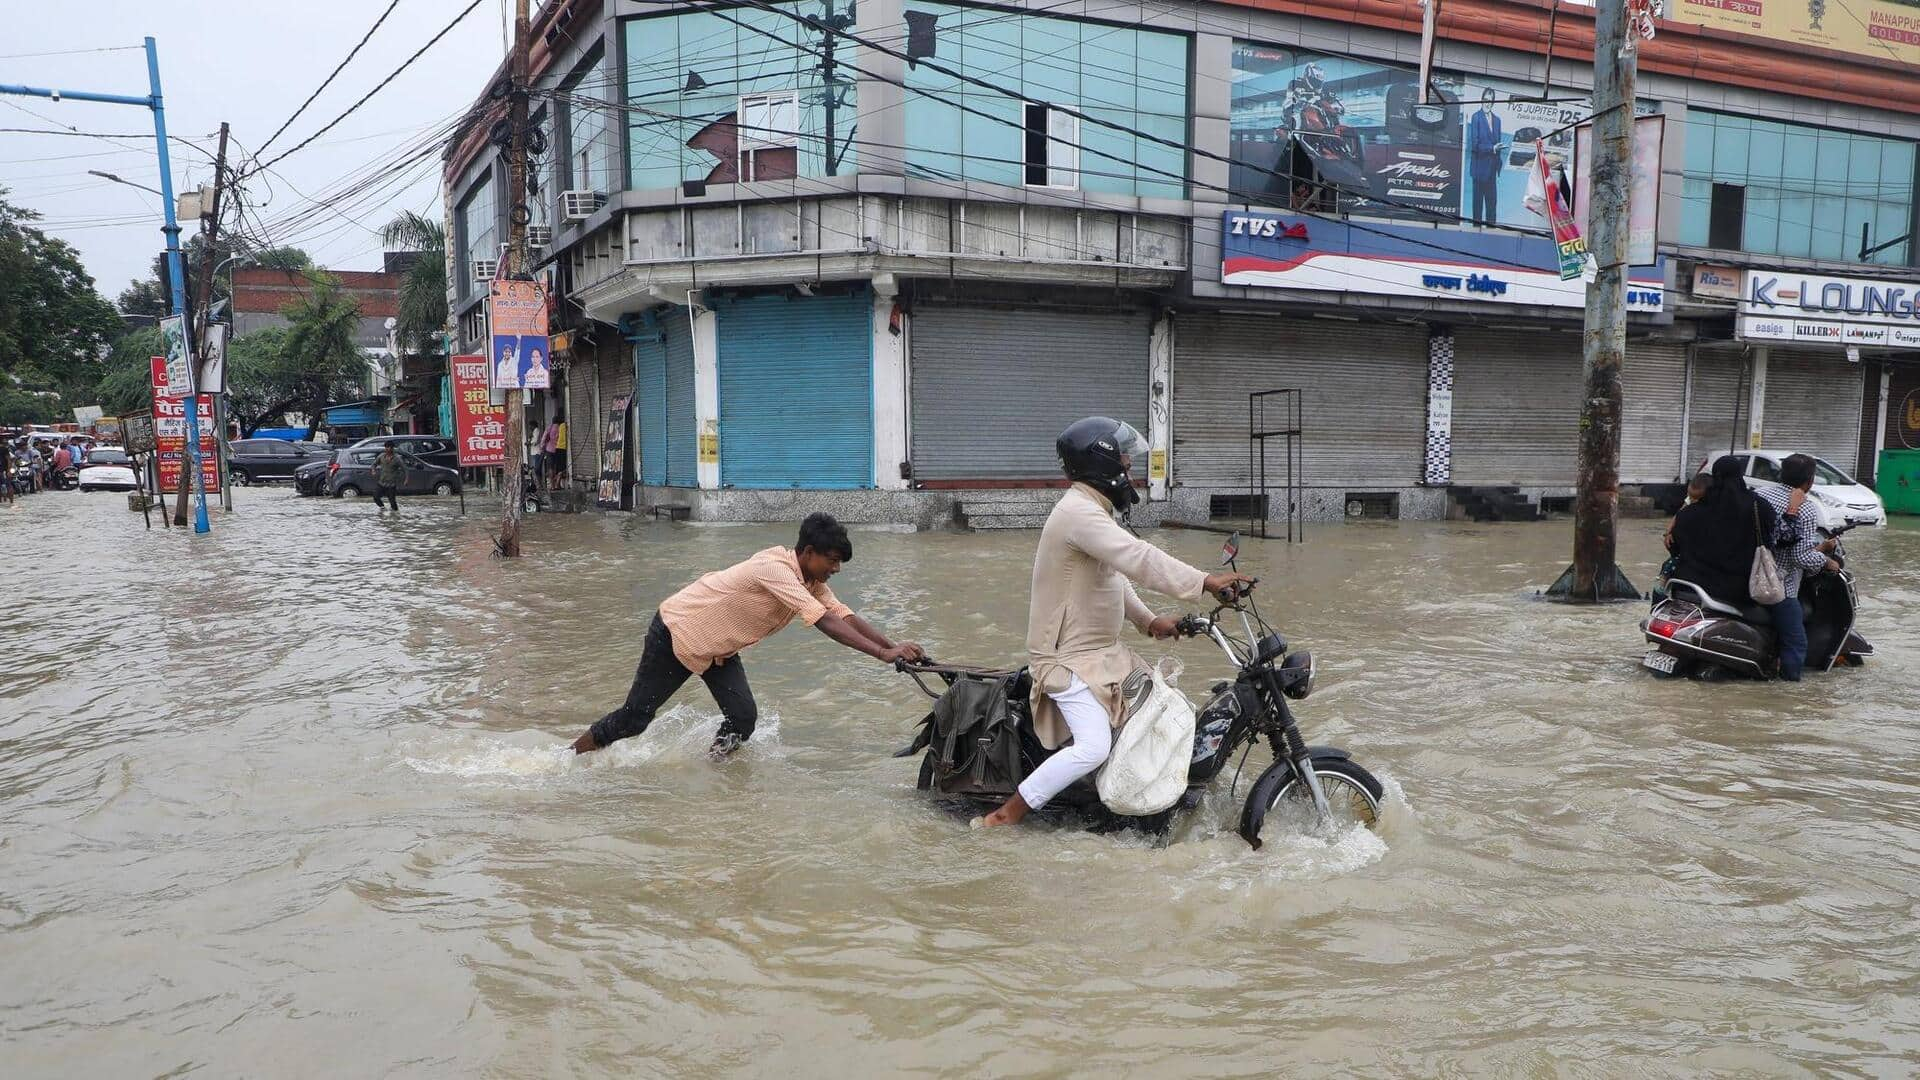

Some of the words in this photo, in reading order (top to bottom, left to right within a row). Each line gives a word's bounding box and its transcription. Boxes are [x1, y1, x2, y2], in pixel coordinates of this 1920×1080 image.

[1729, 1, 1760, 15] ऋण
[1871, 26, 1902, 41] GOLD
[1508, 102, 1523, 113] TVS
[1523, 104, 1558, 117] JUPITER
[1558, 109, 1581, 124] 125
[1376, 161, 1451, 178] Apache
[1387, 177, 1413, 187] RTR
[1232, 217, 1277, 237] TVS
[1700, 272, 1720, 285] Ria
[1639, 291, 1662, 305] TVS
[1796, 324, 1828, 337] KILLER
[466, 436, 505, 452] बिय
